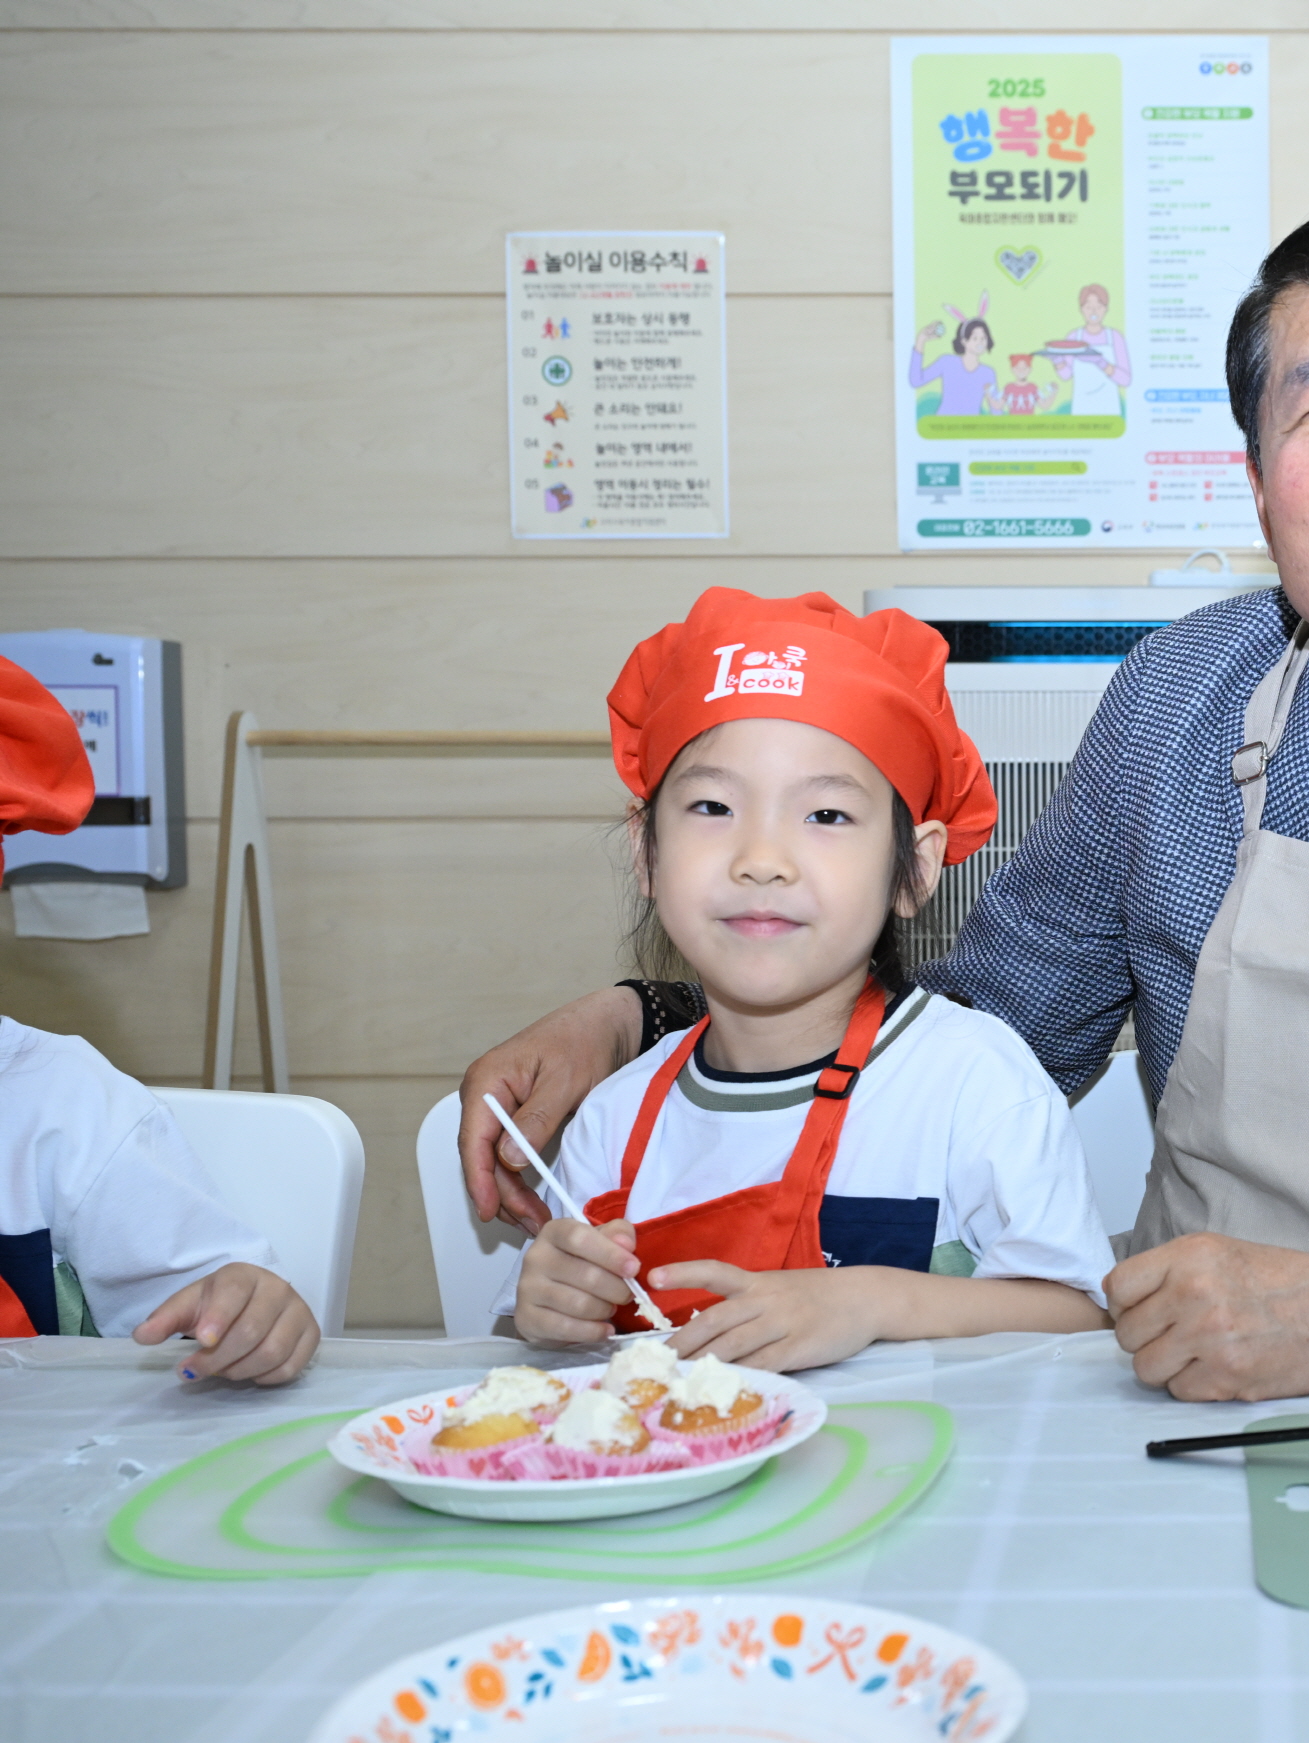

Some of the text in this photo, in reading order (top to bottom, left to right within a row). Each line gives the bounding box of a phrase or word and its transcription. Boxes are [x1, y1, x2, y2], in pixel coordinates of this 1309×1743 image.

[987, 78, 1046, 98] 2025
[940, 106, 1095, 163] 행복한
[947, 168, 1089, 205] 부모되기
[544, 250, 688, 274] 놀이실 이용수칙
[592, 312, 637, 326] 보호자는
[641, 312, 664, 325] 상시
[593, 357, 627, 371] 놀이는
[608, 402, 641, 416] 소리는
[596, 442, 627, 455] 놀이는
[962, 520, 1074, 536] 02-1661-5666
[743, 677, 799, 691] cook
